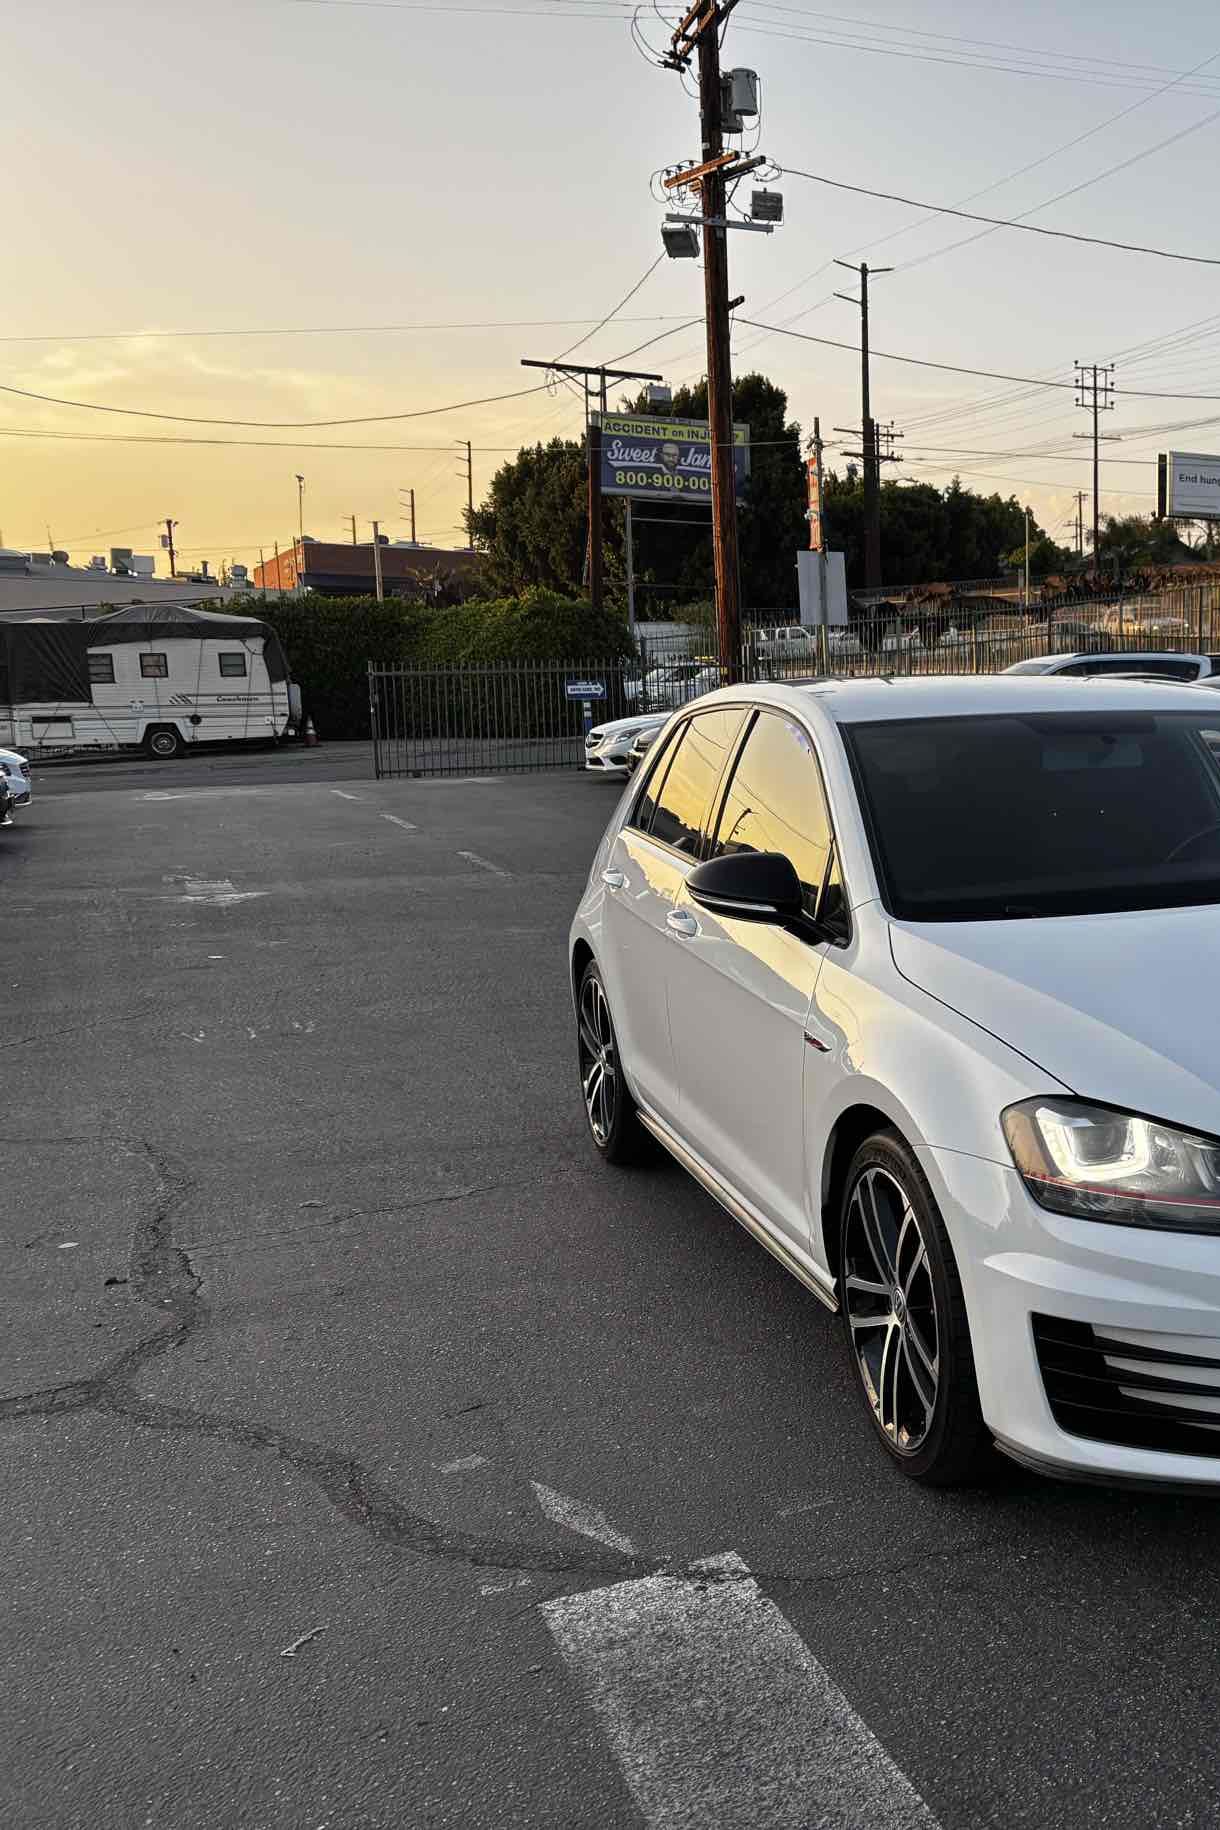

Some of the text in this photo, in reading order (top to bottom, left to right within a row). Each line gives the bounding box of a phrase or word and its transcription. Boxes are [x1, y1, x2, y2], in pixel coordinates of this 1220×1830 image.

[604, 421, 669, 437] ACCIDENT
[607, 440, 659, 463] Sweet
[616, 471, 712, 490] 800-900-00
[1179, 473, 1198, 484] End
